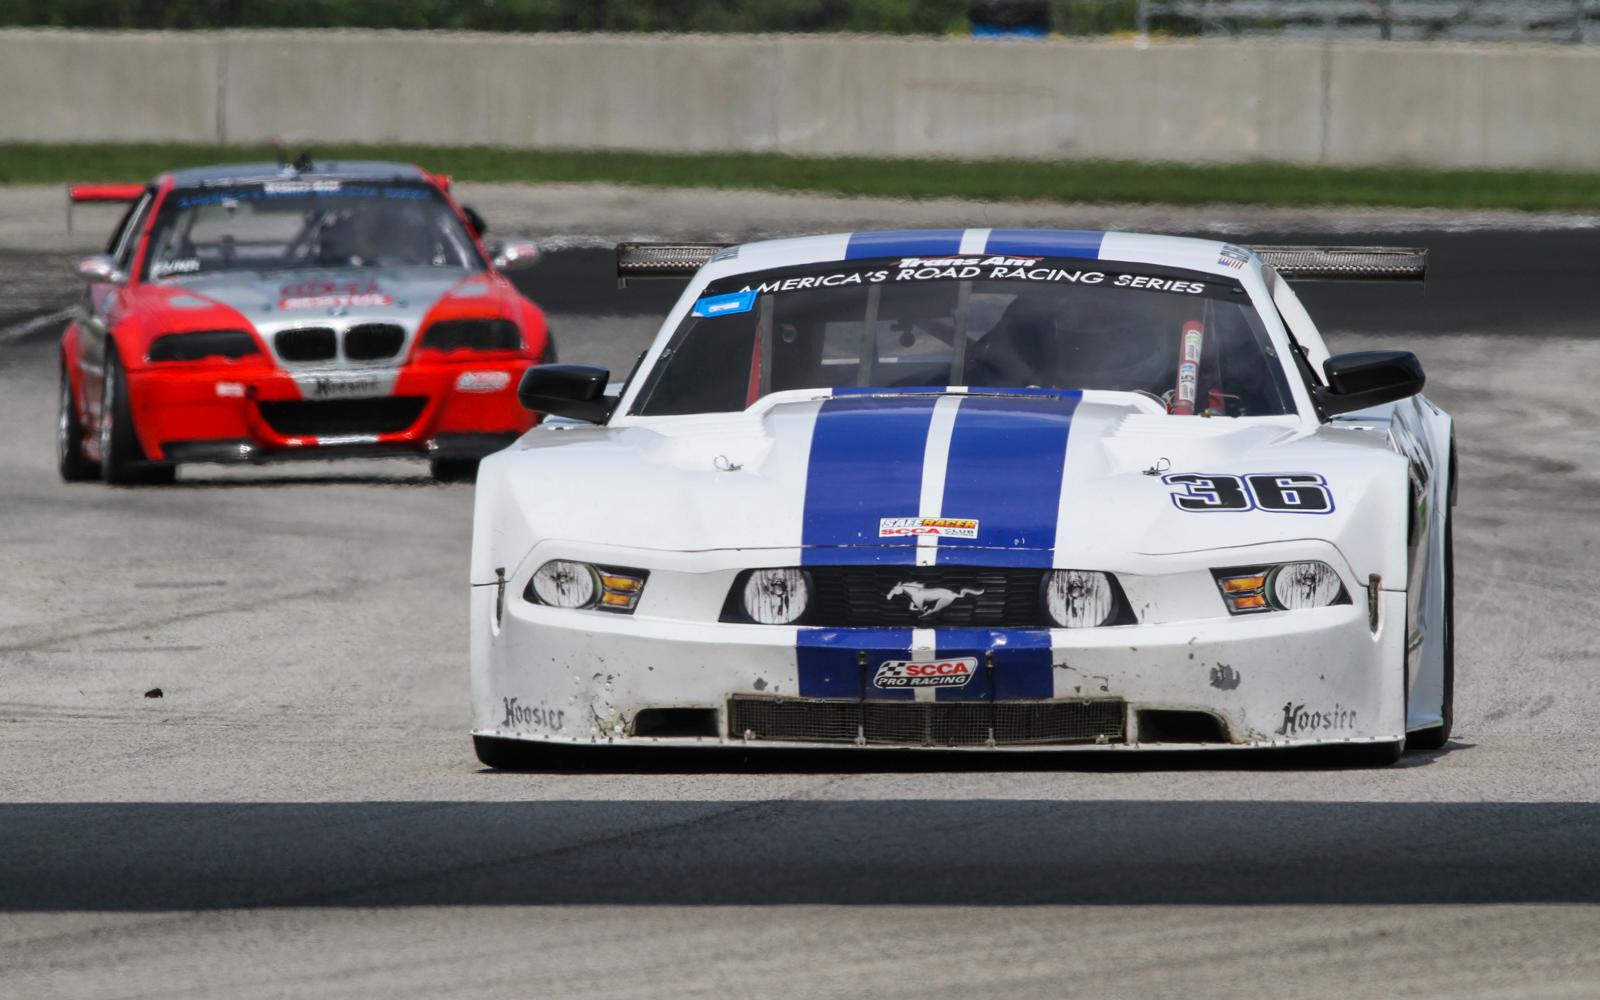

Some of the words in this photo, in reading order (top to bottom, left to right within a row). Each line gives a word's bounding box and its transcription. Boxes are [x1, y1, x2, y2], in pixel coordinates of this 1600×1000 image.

[896, 266, 981, 281] ROAD
[989, 267, 1104, 284] RACING
[1114, 275, 1205, 294] SERIES
[1161, 472, 1336, 515] 36
[878, 677, 908, 686] PRO
[910, 676, 966, 686] RACING
[906, 662, 969, 676] SCCA
[501, 696, 565, 731] Hoosier
[1274, 701, 1357, 735] Hoosier
